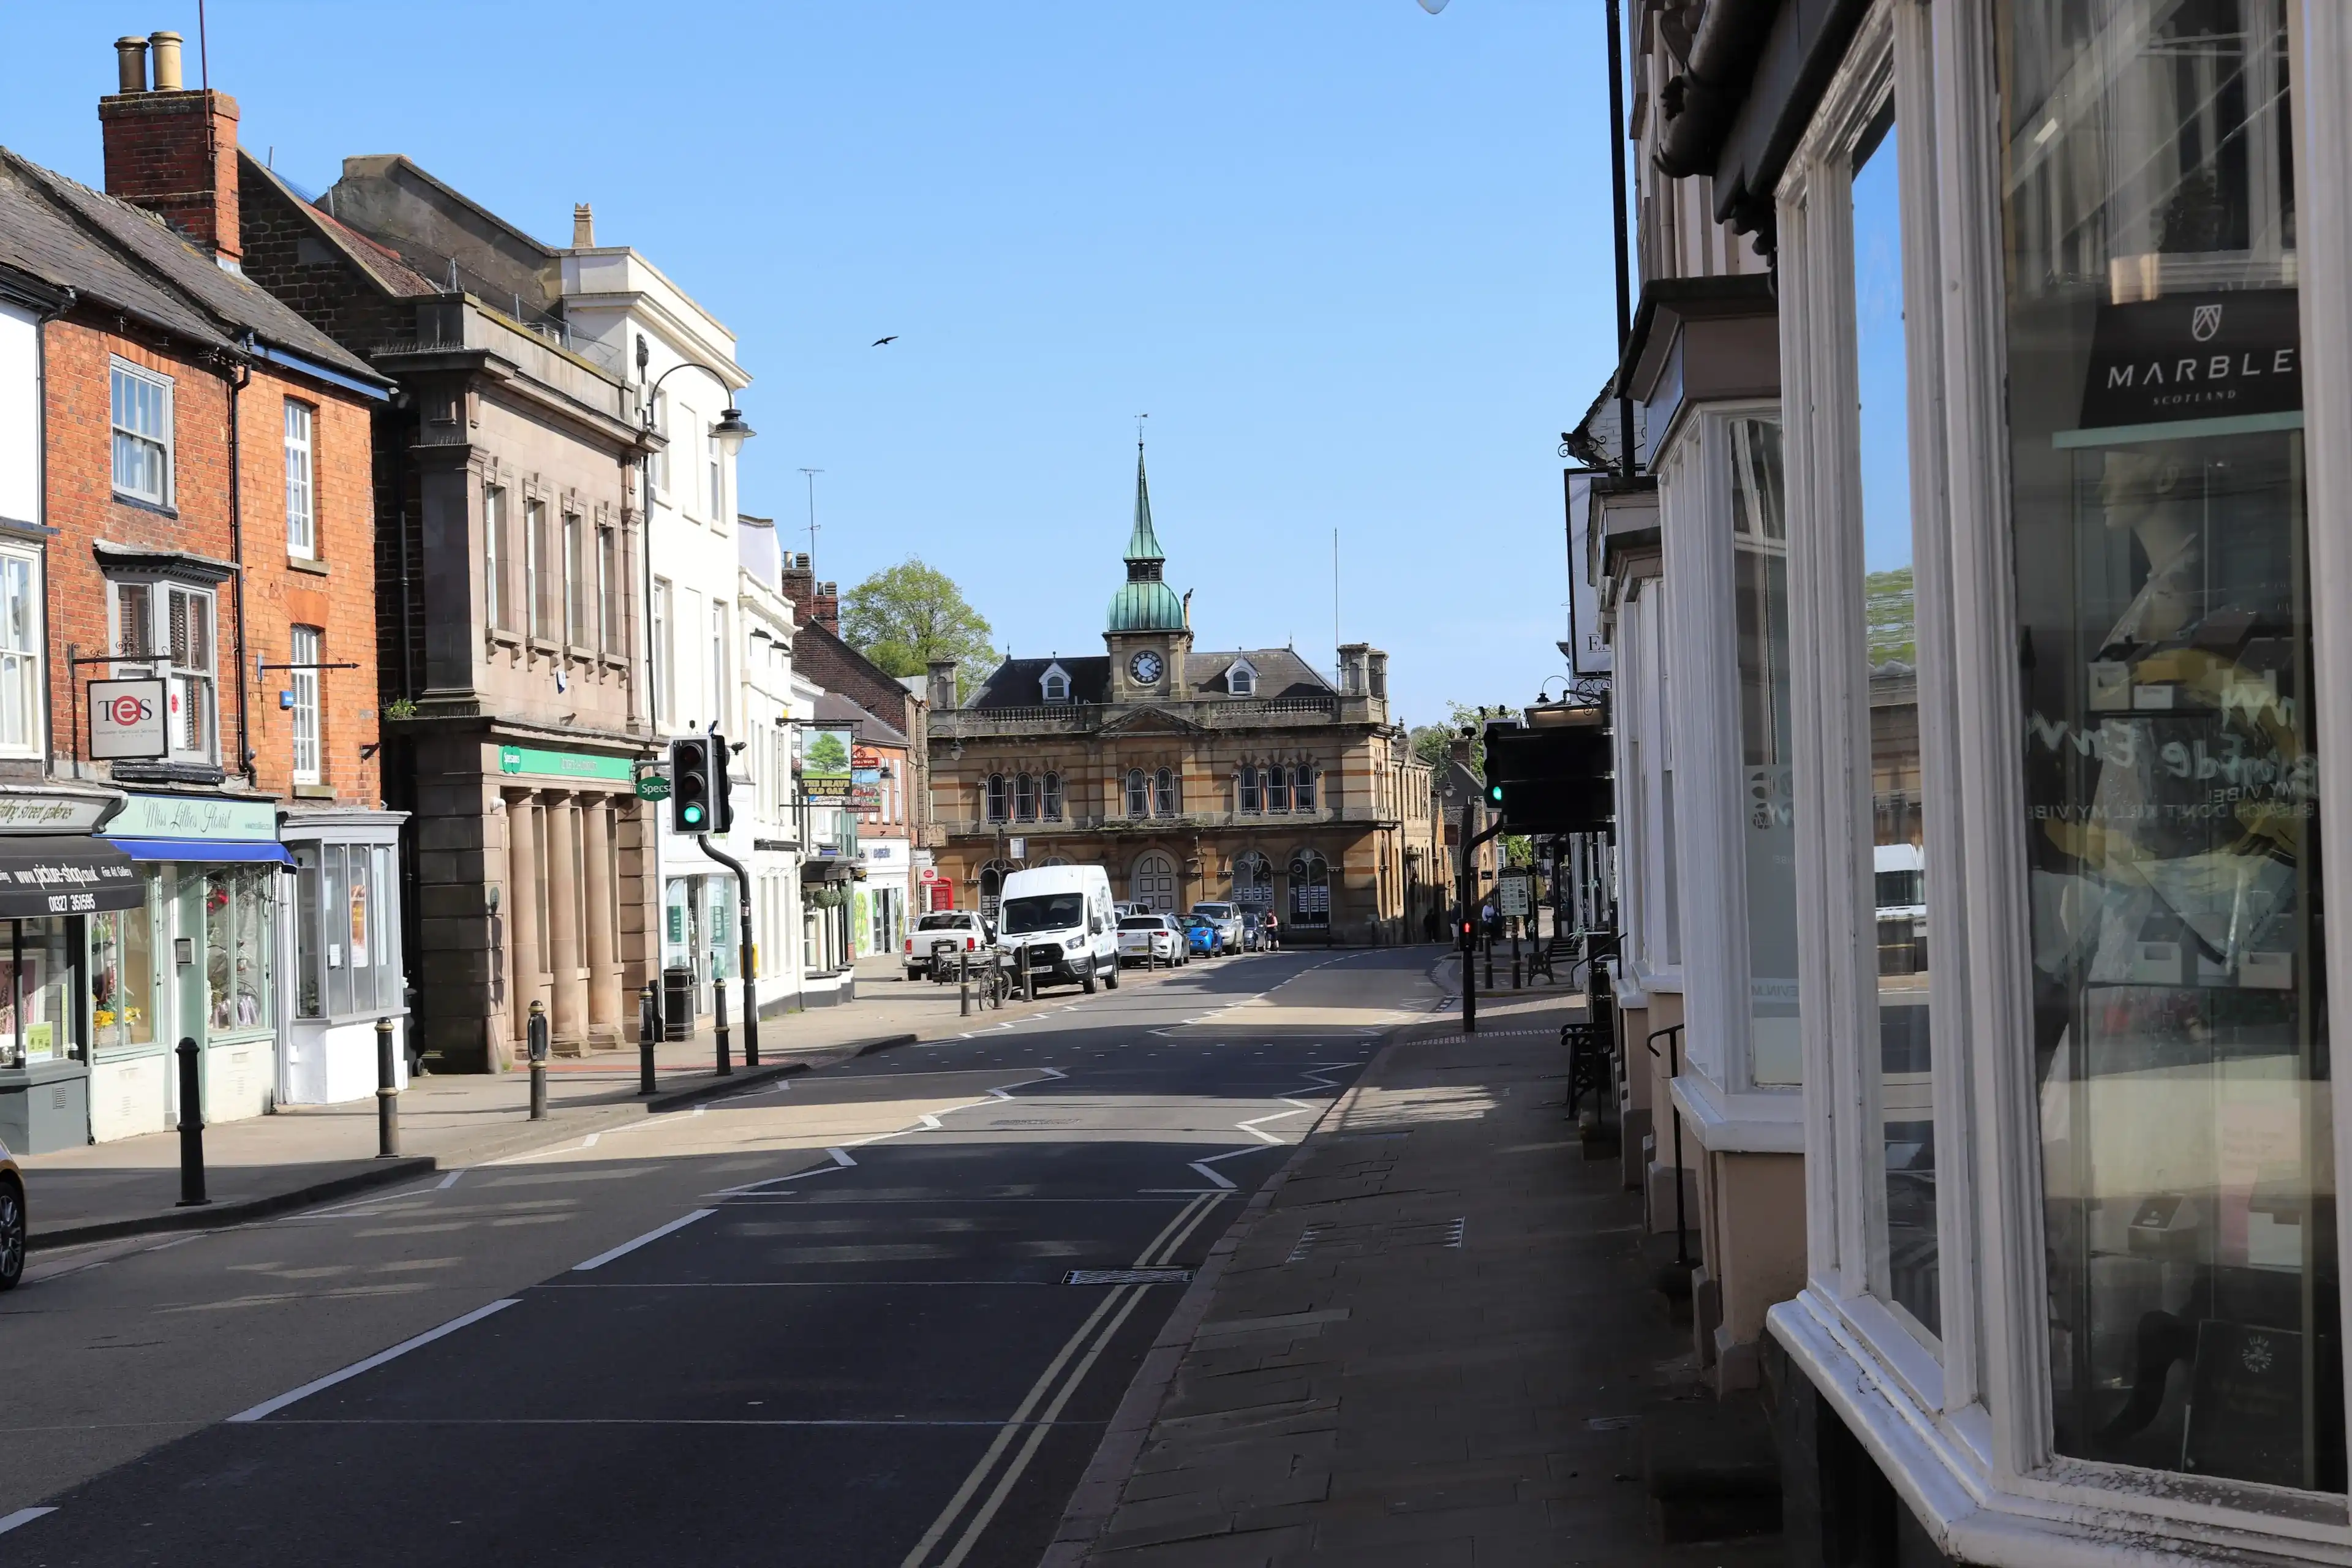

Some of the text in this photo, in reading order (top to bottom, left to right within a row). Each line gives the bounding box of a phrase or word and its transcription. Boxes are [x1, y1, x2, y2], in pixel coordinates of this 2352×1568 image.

[2107, 348, 2294, 390] MARBLE
[2152, 389, 2237, 406] SCOTLAND
[1577, 680, 1613, 691] ENCO
[18, 802, 47, 819] street
[143, 798, 167, 829] Miss
[200, 802, 232, 832] Florist
[13, 863, 101, 890] www.picture-shop.co.uk
[48, 893, 96, 912] 01327 351595
